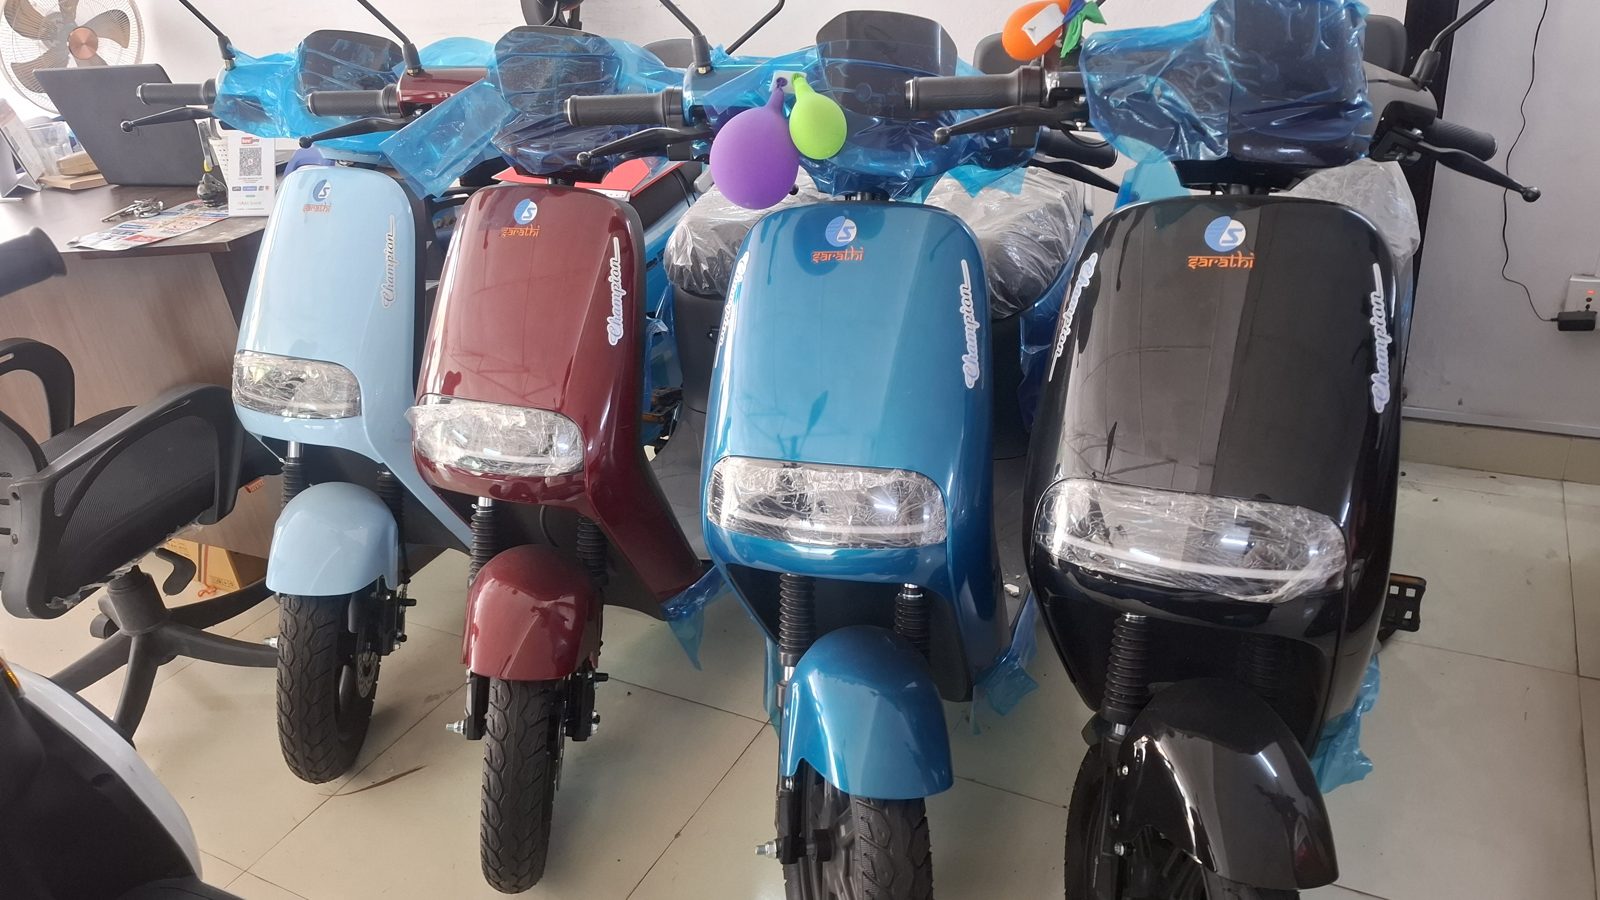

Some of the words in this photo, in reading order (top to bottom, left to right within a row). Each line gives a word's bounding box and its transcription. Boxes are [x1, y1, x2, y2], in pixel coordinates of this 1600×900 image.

[381, 214, 398, 308] Champion
[607, 237, 626, 345] Champion
[812, 246, 864, 263] sarathi
[1187, 250, 1255, 269] sarathi
[960, 259, 980, 389] Champion
[1370, 263, 1391, 413] Champion
